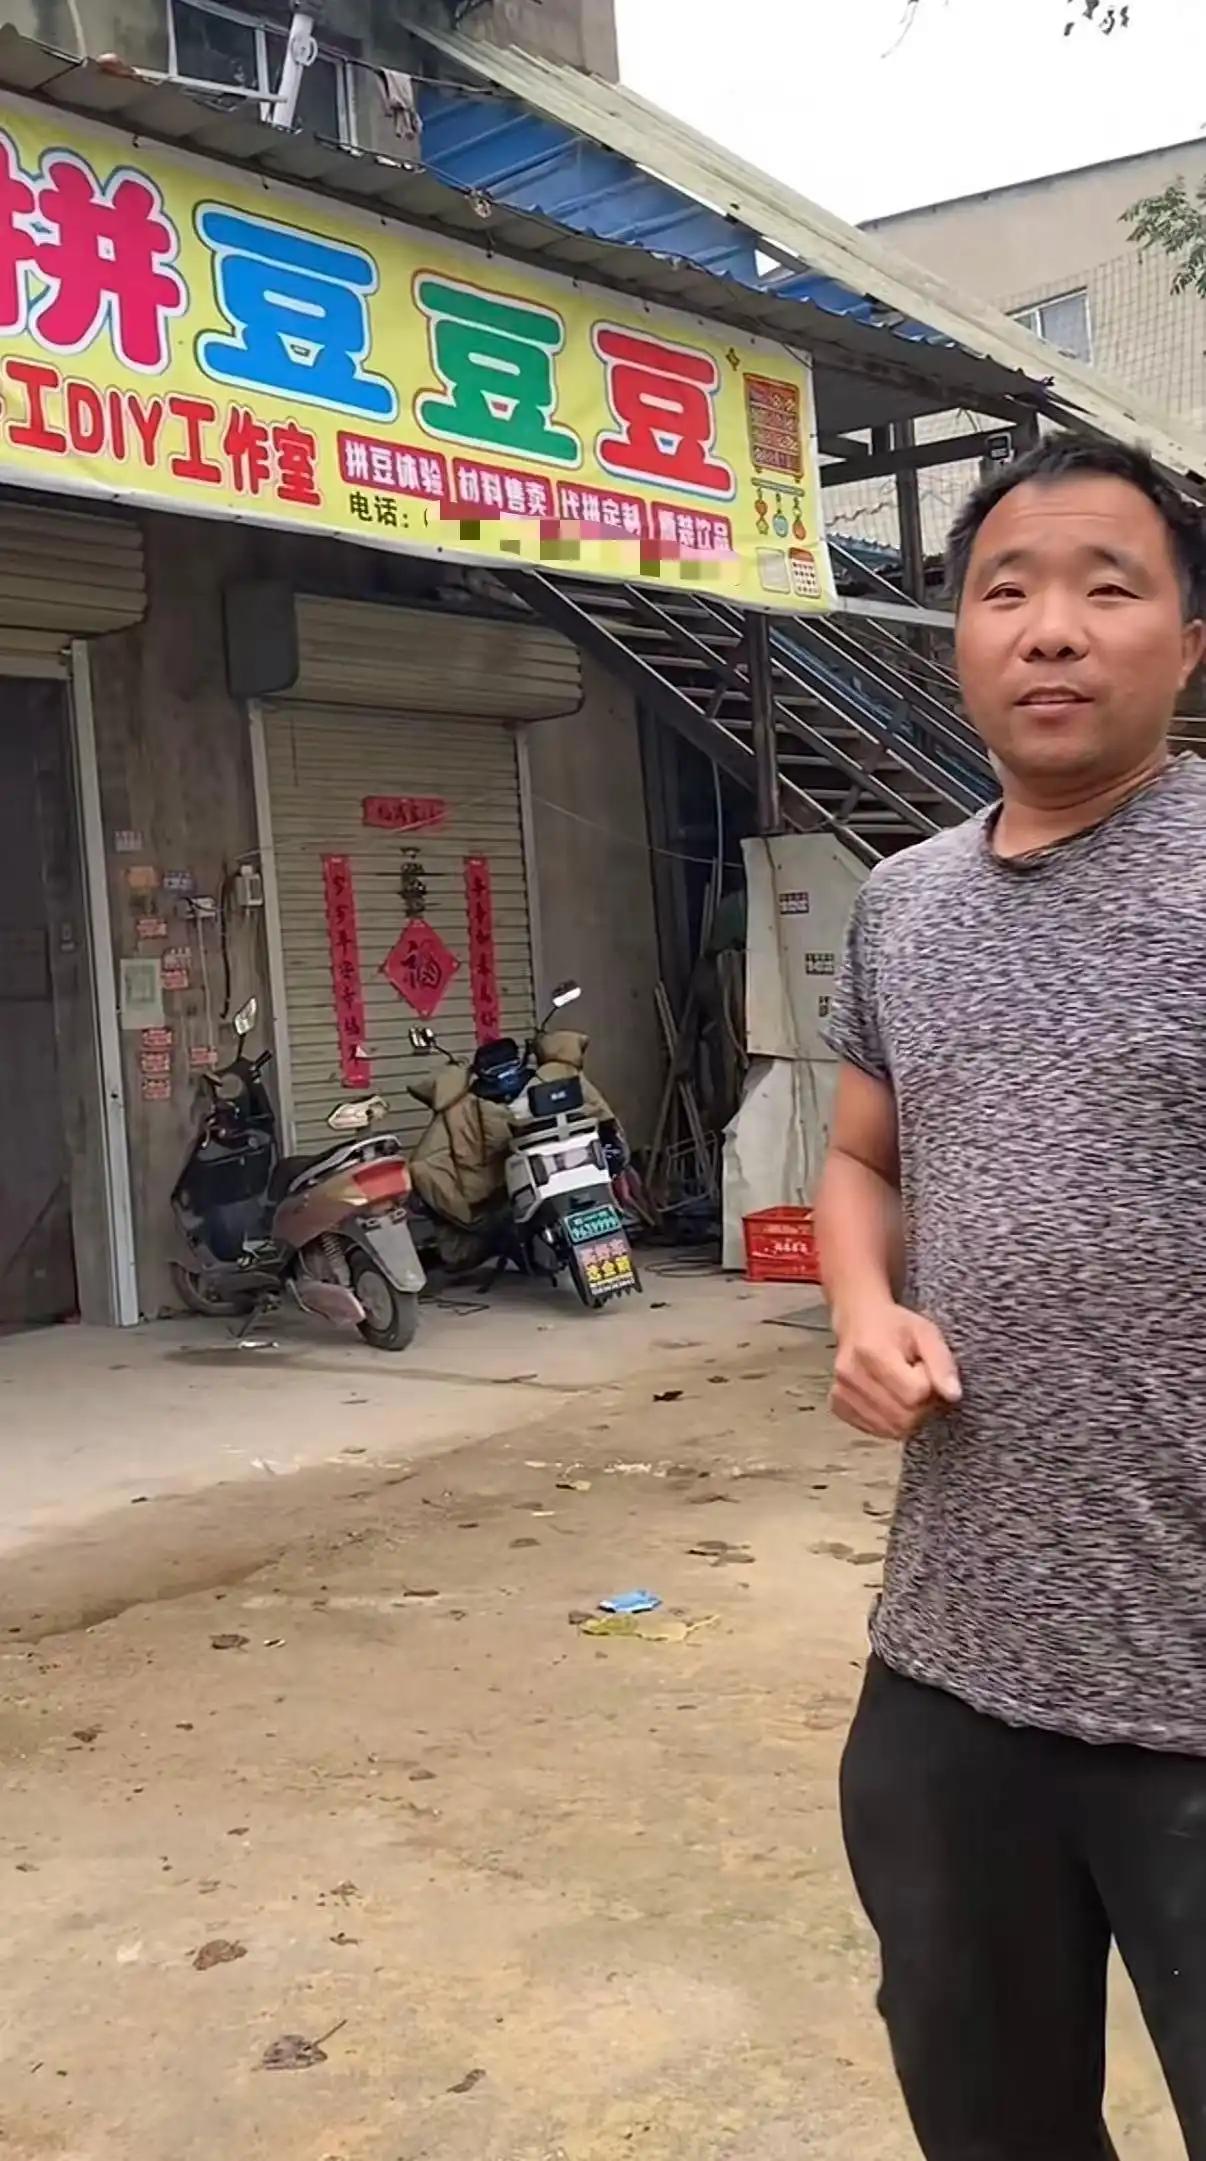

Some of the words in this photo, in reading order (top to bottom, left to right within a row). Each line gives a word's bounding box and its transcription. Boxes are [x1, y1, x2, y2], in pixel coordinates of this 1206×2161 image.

[0, 360, 322, 506] 工DIY工作室
[345, 439, 445, 497] 拼豆体验
[457, 466, 547, 516] 材料售卖
[400, 939, 443, 990] 福
